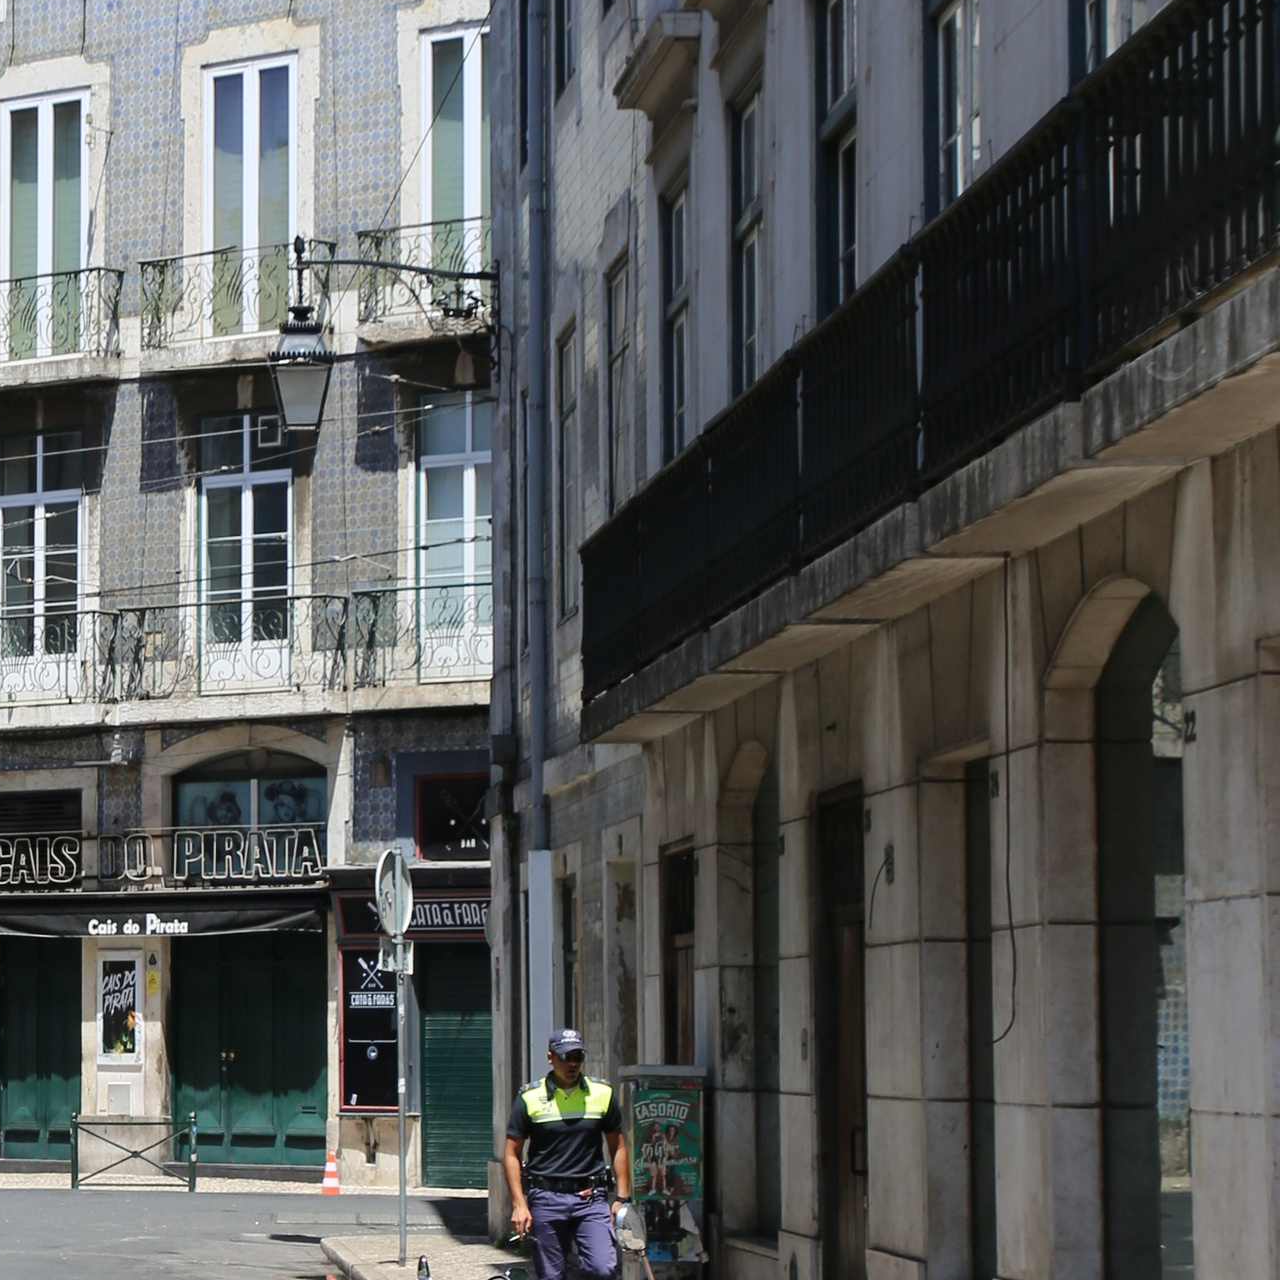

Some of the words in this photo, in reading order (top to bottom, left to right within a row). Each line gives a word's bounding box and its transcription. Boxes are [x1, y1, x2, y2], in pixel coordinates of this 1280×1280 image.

[97, 834, 155, 881] DO
[174, 828, 323, 880] PIRATA
[460, 838, 476, 849] BAR
[87, 918, 118, 935] Cais
[122, 918, 140, 934] do
[145, 913, 189, 935] Pirata
[102, 973, 121, 995] CAIS
[103, 986, 135, 1015] PIRATA
